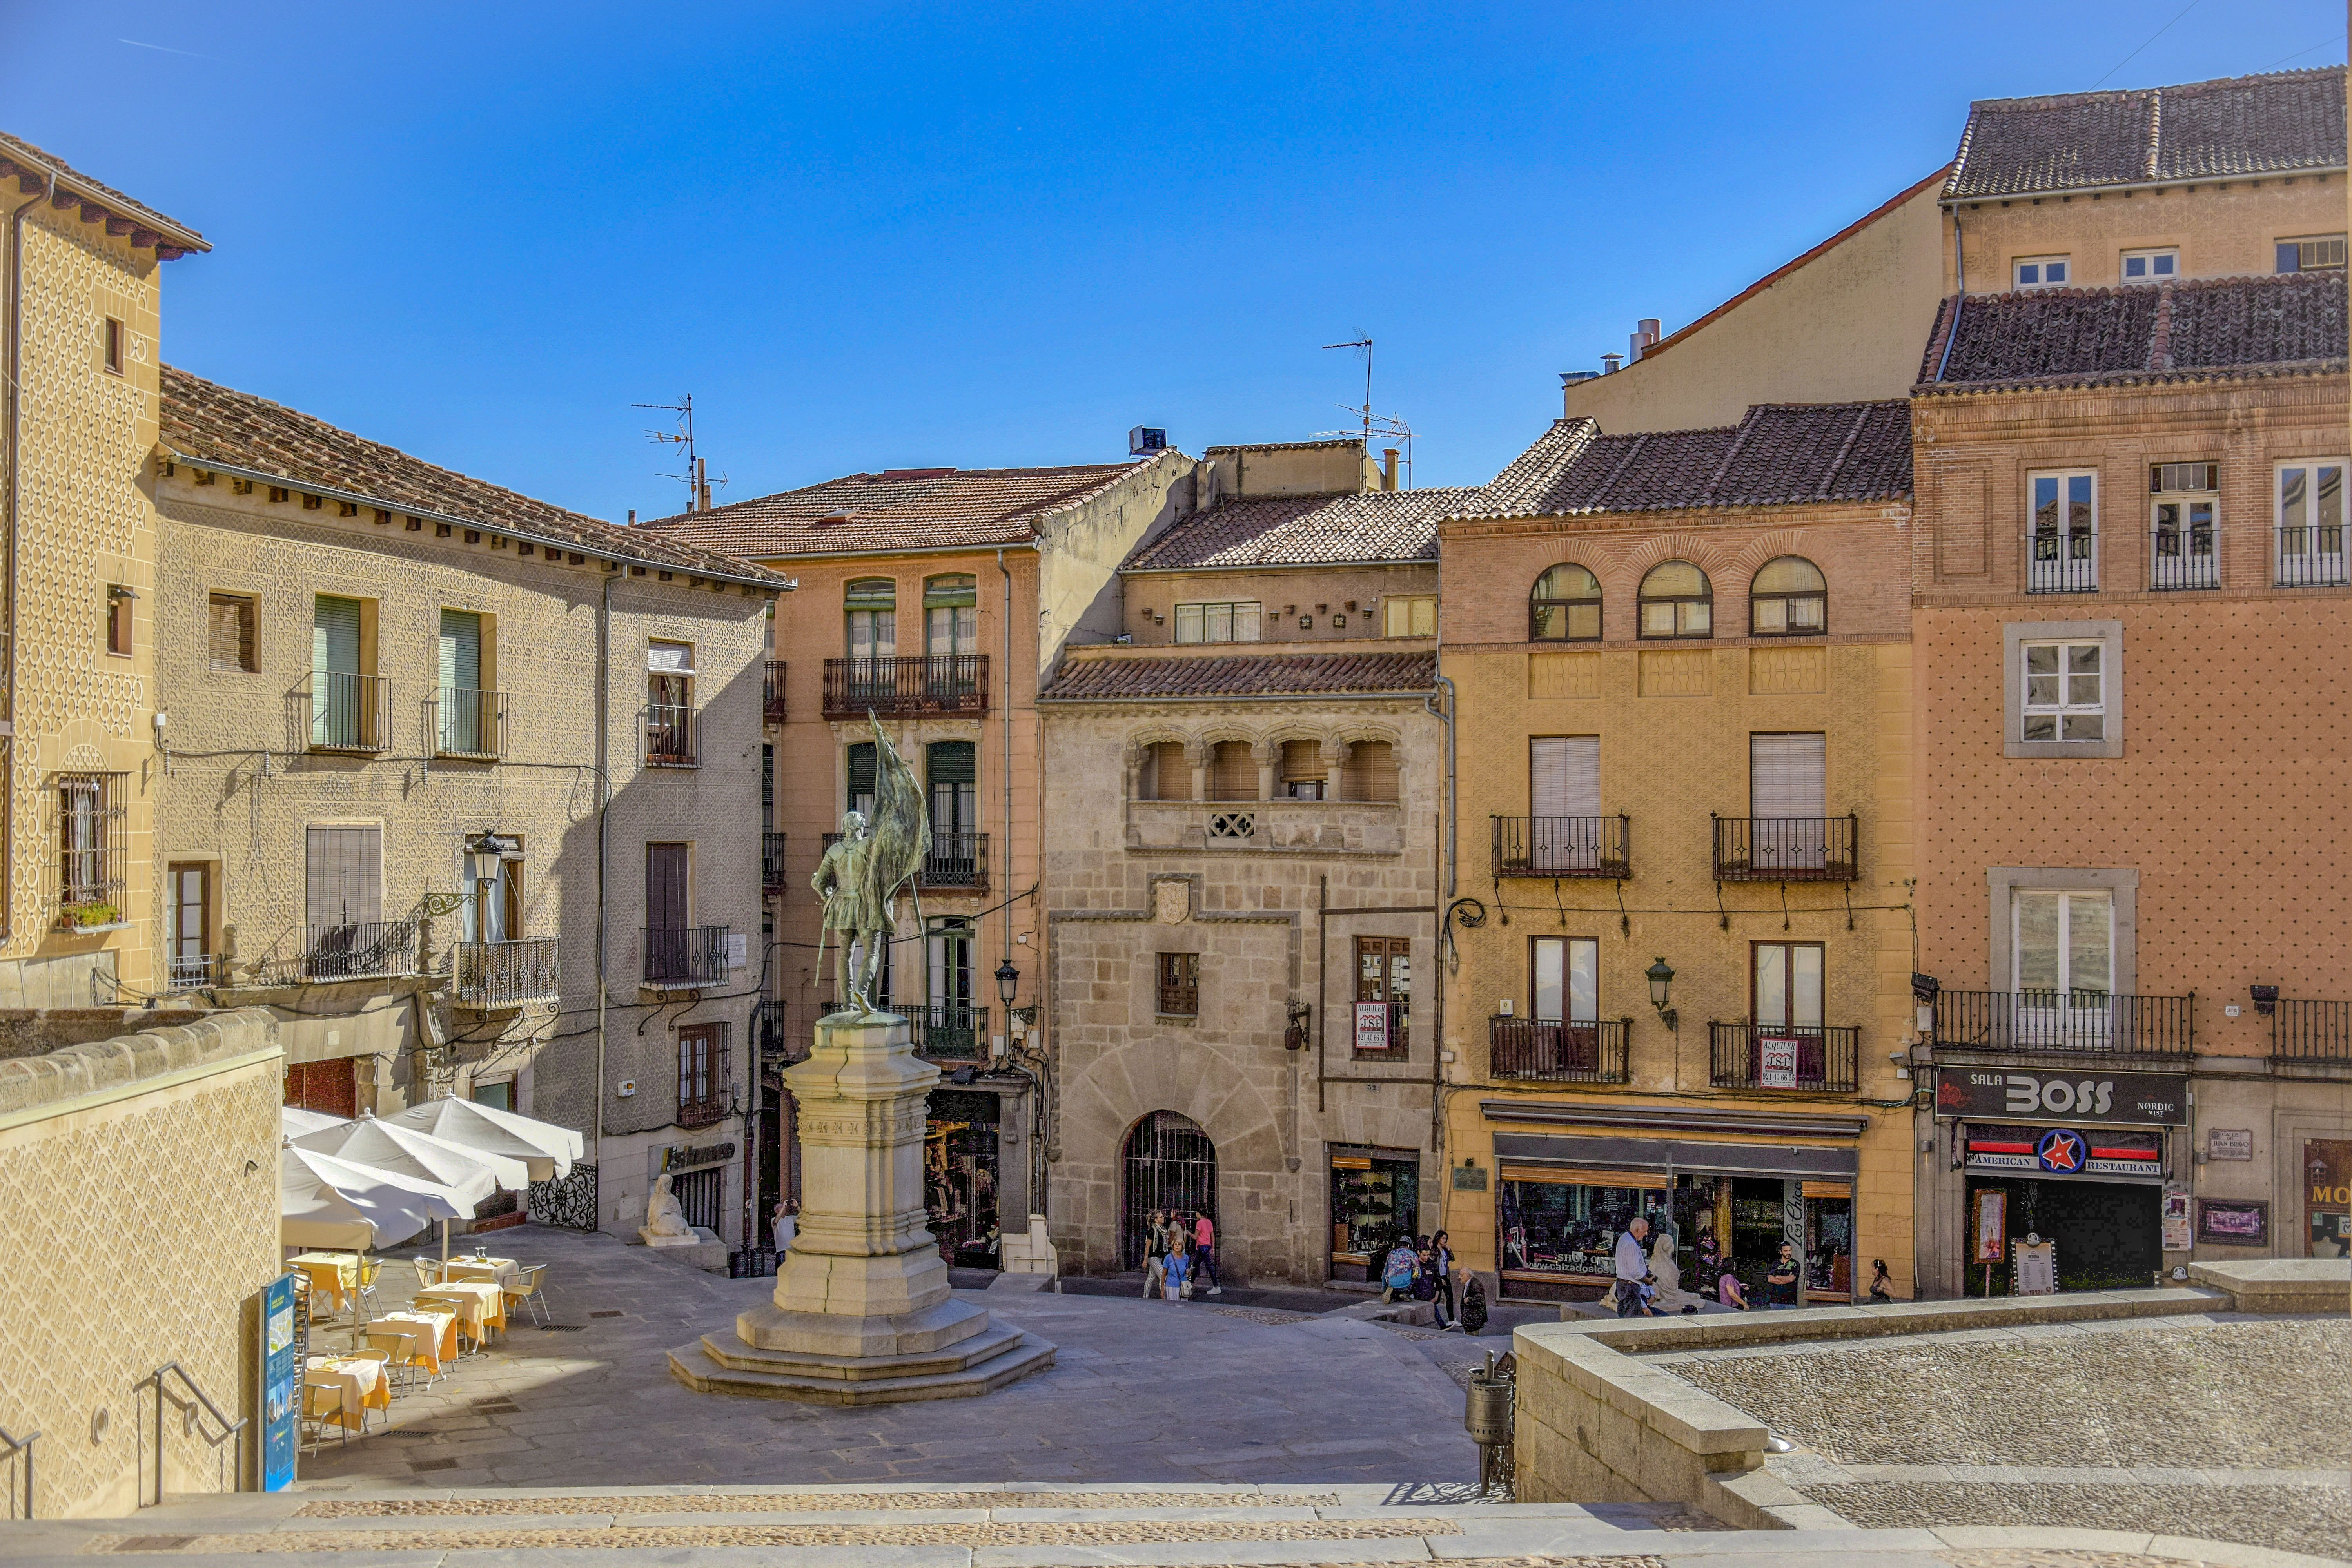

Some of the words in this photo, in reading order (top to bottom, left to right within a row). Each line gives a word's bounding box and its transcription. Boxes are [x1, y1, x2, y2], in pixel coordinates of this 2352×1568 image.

[1358, 1005, 1385, 1013] ALQUILER
[1764, 1041, 1795, 1051] ALQUILER
[1971, 1074, 2002, 1085] SALA
[2006, 1076, 2113, 1114] BOSS
[2137, 1102, 2174, 1111] NØRDIC
[1975, 1157, 2031, 1165] AMERICAN
[2087, 1161, 2159, 1172] RESTAURANT
[1786, 1179, 1802, 1221] Chico
[1786, 1223, 1802, 1250] Los
[1558, 1254, 1587, 1263] SHOP
